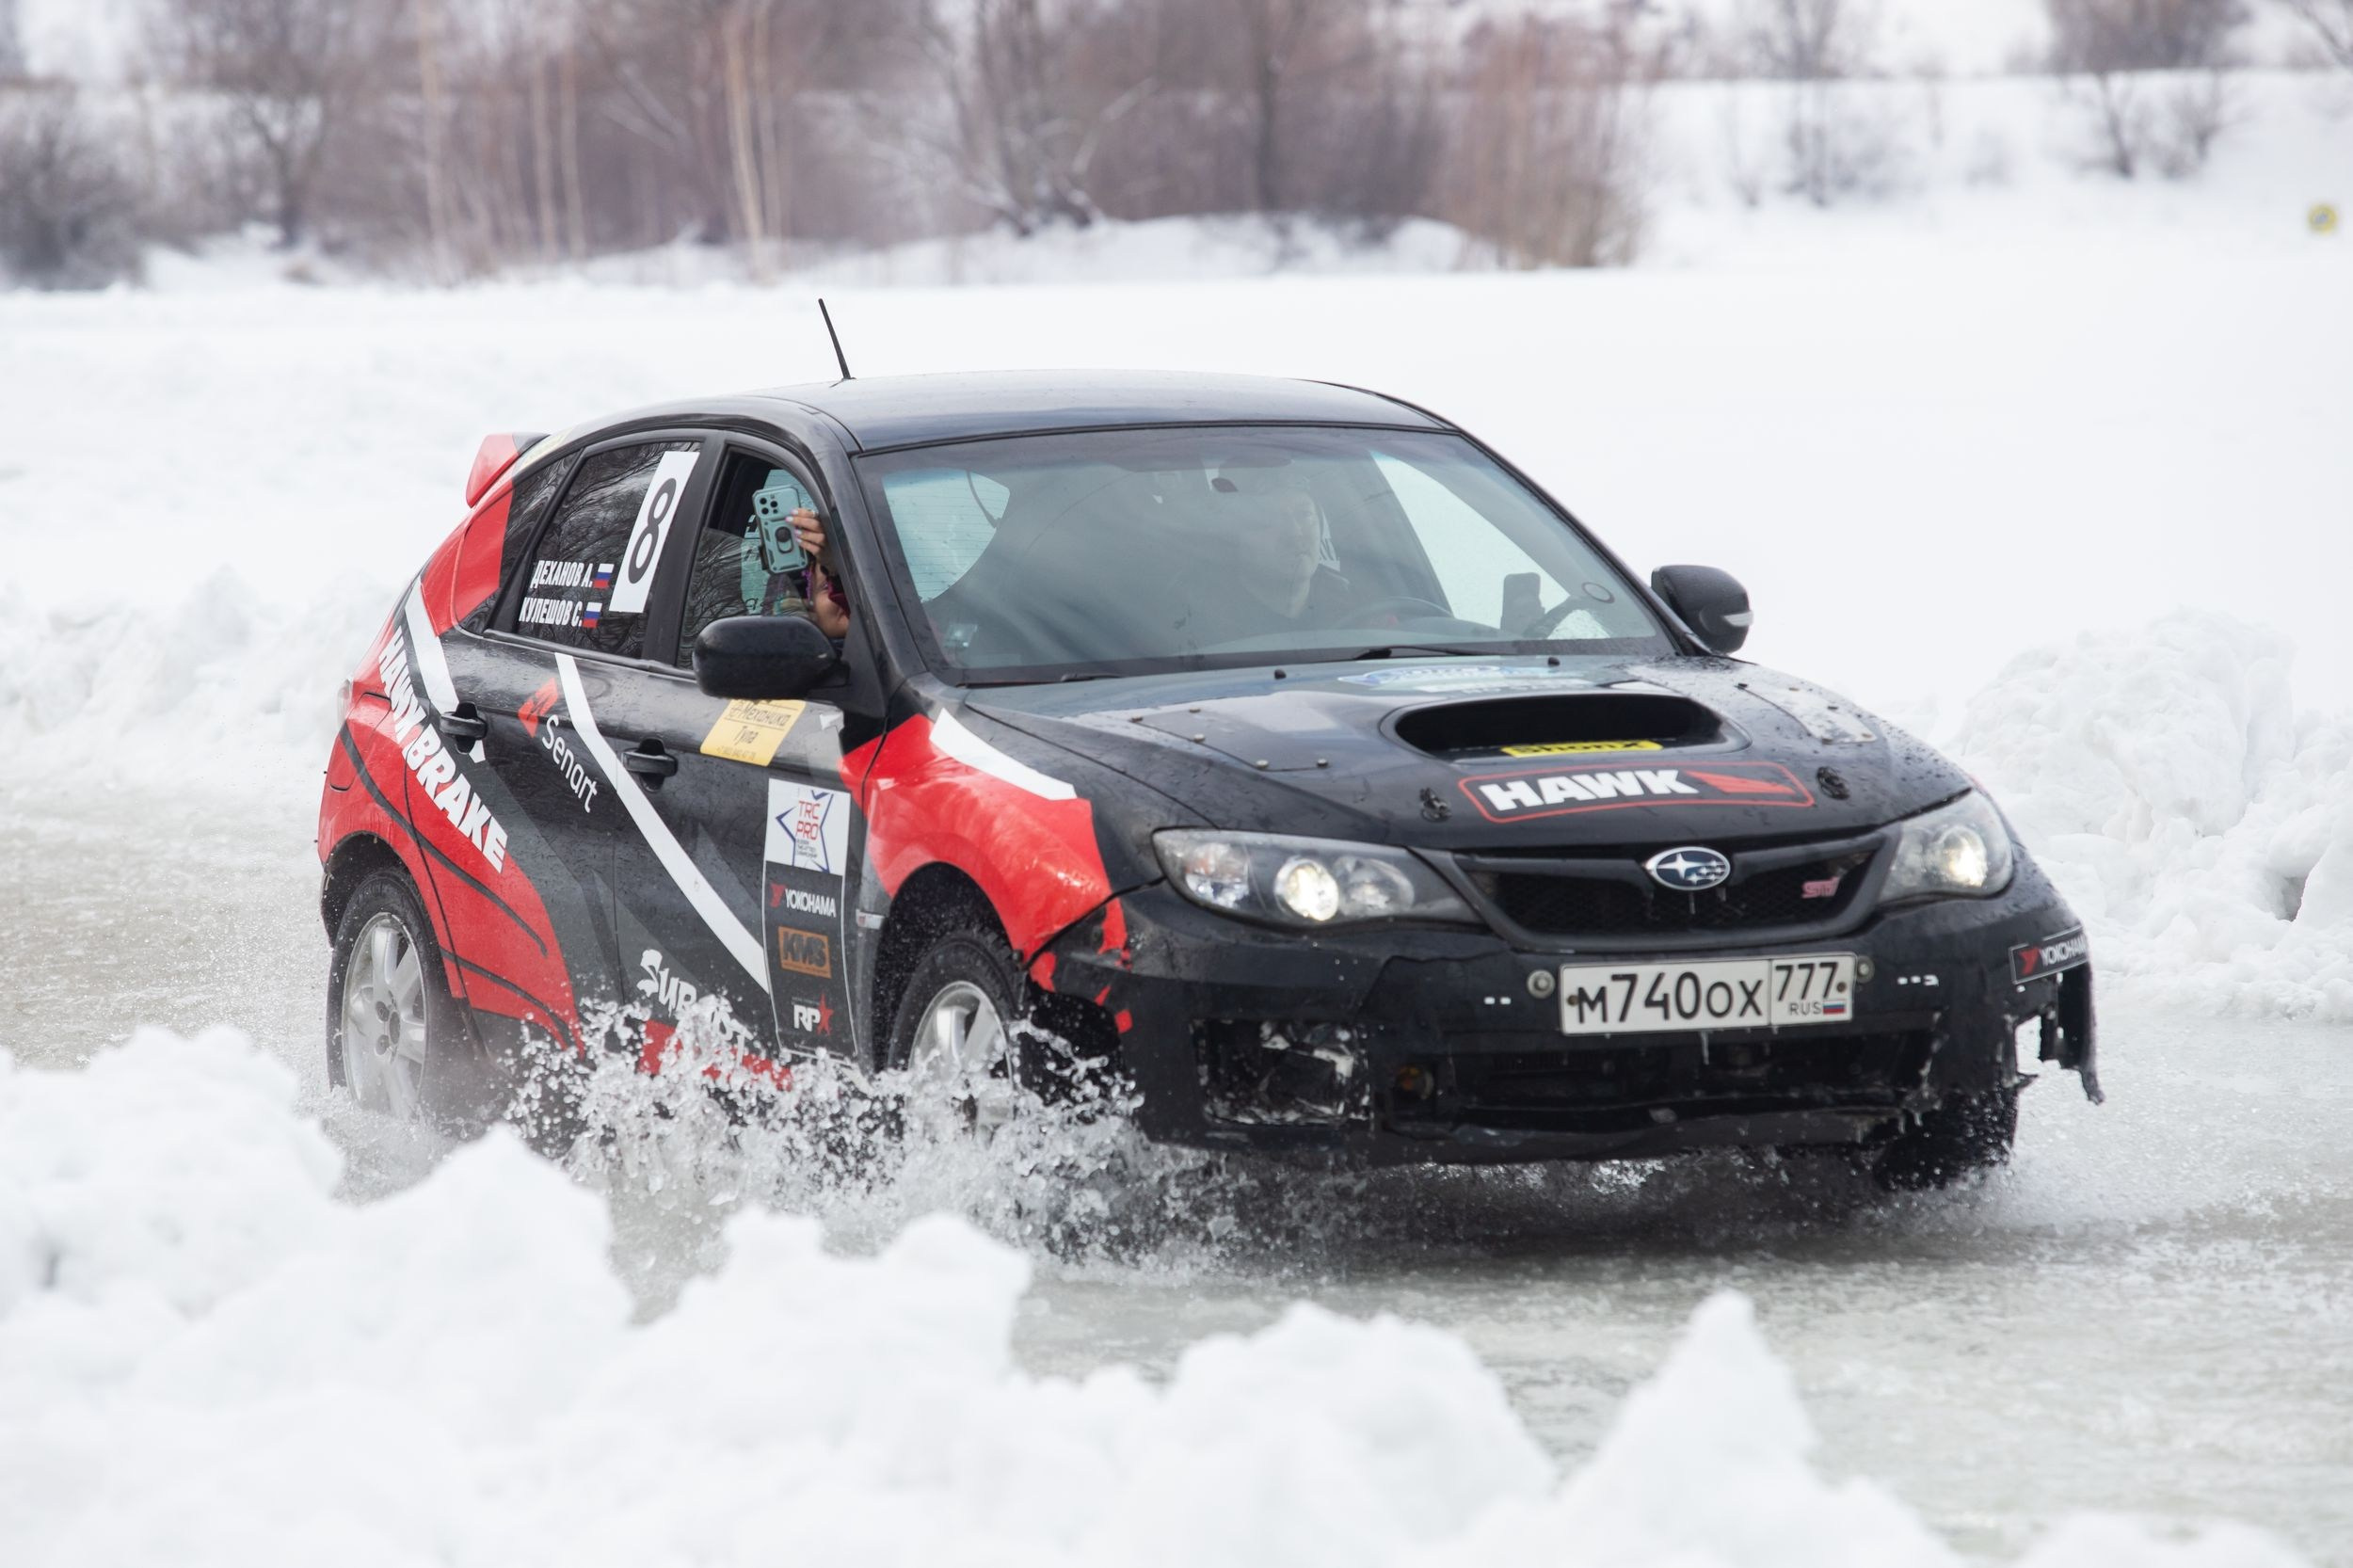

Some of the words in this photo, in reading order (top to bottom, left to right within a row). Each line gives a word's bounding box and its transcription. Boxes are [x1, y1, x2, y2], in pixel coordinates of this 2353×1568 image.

[628, 478, 677, 584] 8
[519, 597, 574, 626] КУЛЕШОВ
[541, 713, 598, 813] Senart
[402, 722, 508, 874] BRAKE
[1479, 768, 1700, 811] HAWK
[798, 800, 821, 820] TRC
[795, 820, 819, 840] PRO
[784, 888, 837, 918] YOKOHAMA
[1775, 962, 1839, 1001] 777
[1789, 1001, 1822, 1016] RUS
